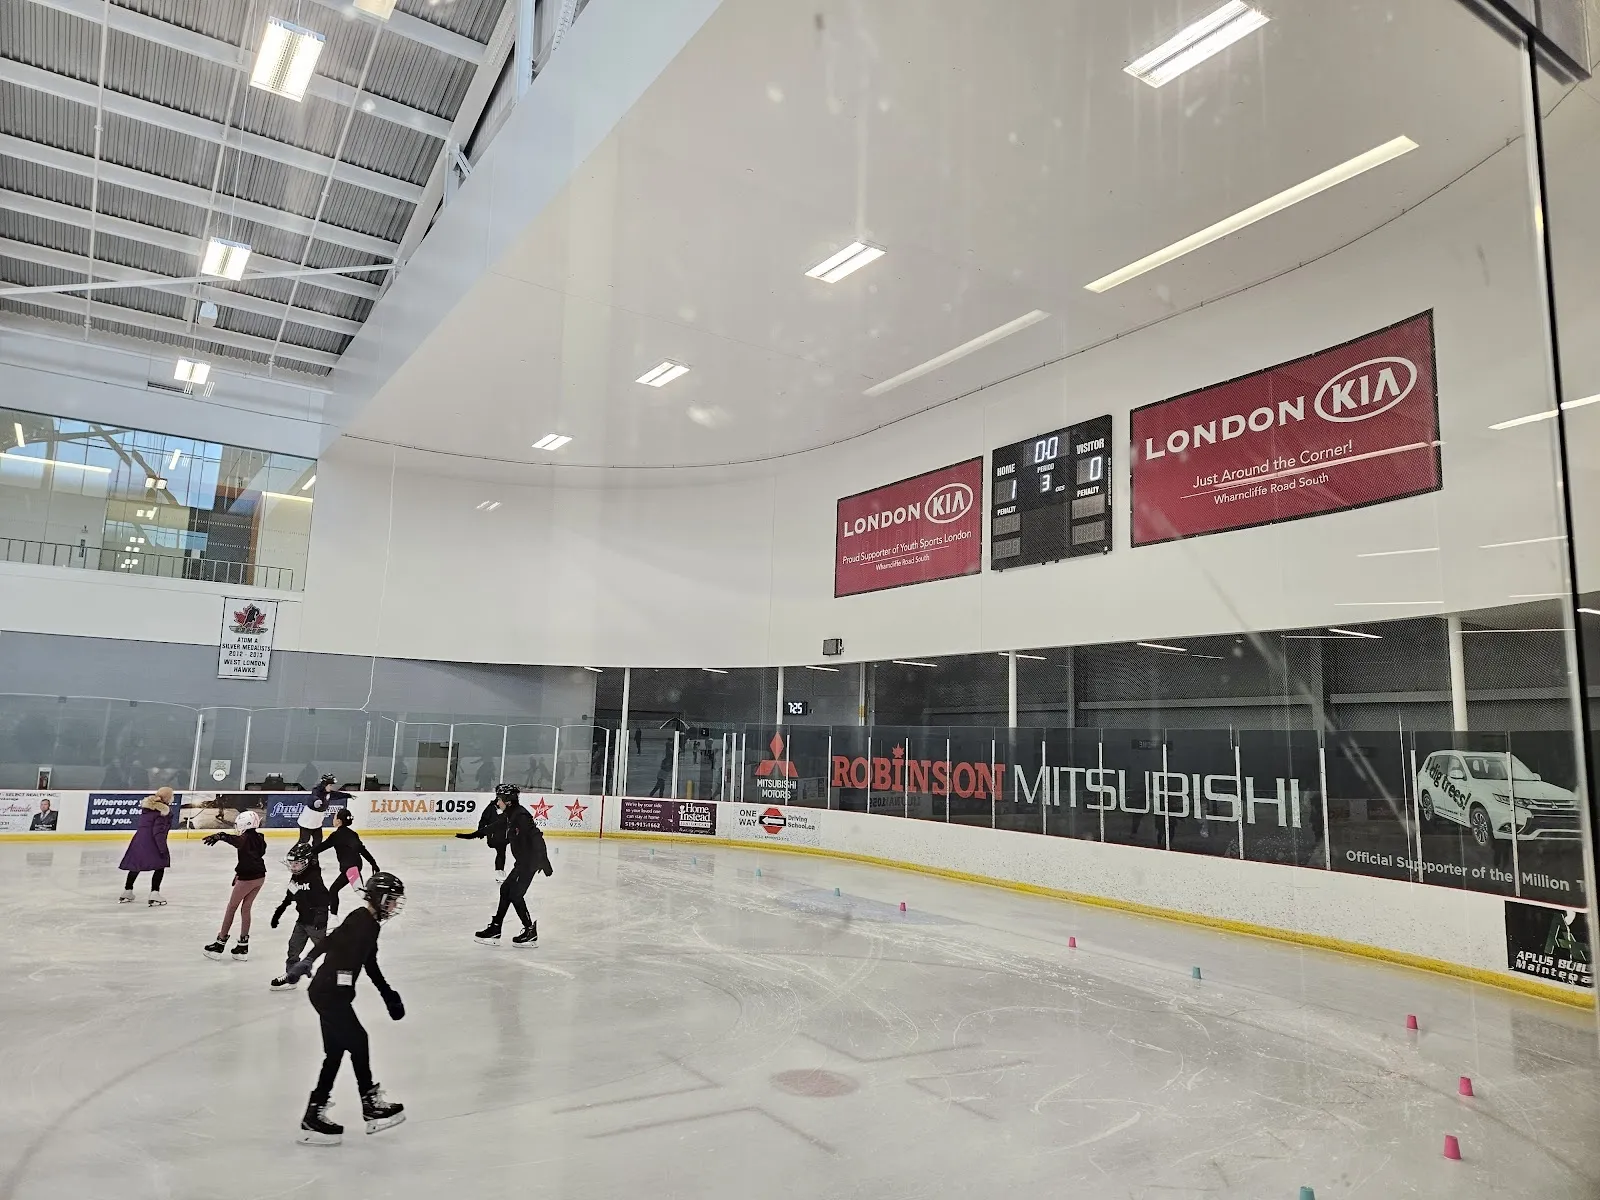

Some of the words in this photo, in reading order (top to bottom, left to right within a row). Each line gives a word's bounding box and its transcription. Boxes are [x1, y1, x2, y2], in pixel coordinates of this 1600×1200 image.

[1145, 396, 1305, 461] LONDON
[1331, 367, 1401, 414] KIA
[1076, 438, 1104, 454] VISITOR
[997, 463, 1016, 477] HOME
[1037, 463, 1055, 474] PERIOD
[1089, 456, 1102, 480] 0
[1193, 473, 1218, 489] Just
[1221, 459, 1269, 482] Around
[1273, 455, 1296, 471] the
[1300, 440, 1353, 464] Corner!
[1011, 479, 1017, 500] 1
[1041, 474, 1050, 492] 3
[1214, 485, 1268, 505] Wharncliffe
[1270, 479, 1296, 494] Road
[1299, 473, 1329, 489] South
[1076, 486, 1100, 498] PENALTY
[843, 502, 921, 538] LONDON
[931, 490, 965, 517] KIA
[997, 505, 1017, 516] PENALTY
[842, 553, 860, 565] Proud
[860, 548, 891, 561] Supporter
[892, 544, 900, 554] of
[900, 539, 919, 552] Youth
[920, 536, 943, 550] Sports
[944, 530, 972, 544] London
[902, 557, 914, 567] Road
[915, 554, 930, 564] South
[242, 644, 271, 652] MEDALISTS
[756, 778, 797, 789] MITSUBISHI
[1429, 764, 1444, 788] dig
[1442, 774, 1472, 810] trees!
[761, 789, 791, 799] MOTORS
[831, 754, 1006, 800] ROBINSON
[1014, 764, 1302, 829] MITSUBISHI
[93, 798, 139, 806] Wherever
[435, 799, 476, 813] 1059
[685, 803, 709, 814] Home
[679, 812, 711, 822] Instead
[739, 809, 757, 817] ONE
[788, 815, 808, 823] Driving
[90, 817, 111, 825] with
[112, 818, 132, 826] you.
[739, 818, 757, 827] WAY
[1346, 849, 1393, 867] Official
[1396, 856, 1468, 877] Supporter
[1471, 866, 1486, 879] of
[1490, 868, 1513, 883] the
[1522, 872, 1570, 892] Million
[1516, 950, 1554, 967] APLUS
[1557, 958, 1591, 974] BUIL
[1515, 958, 1592, 984] Maintena
